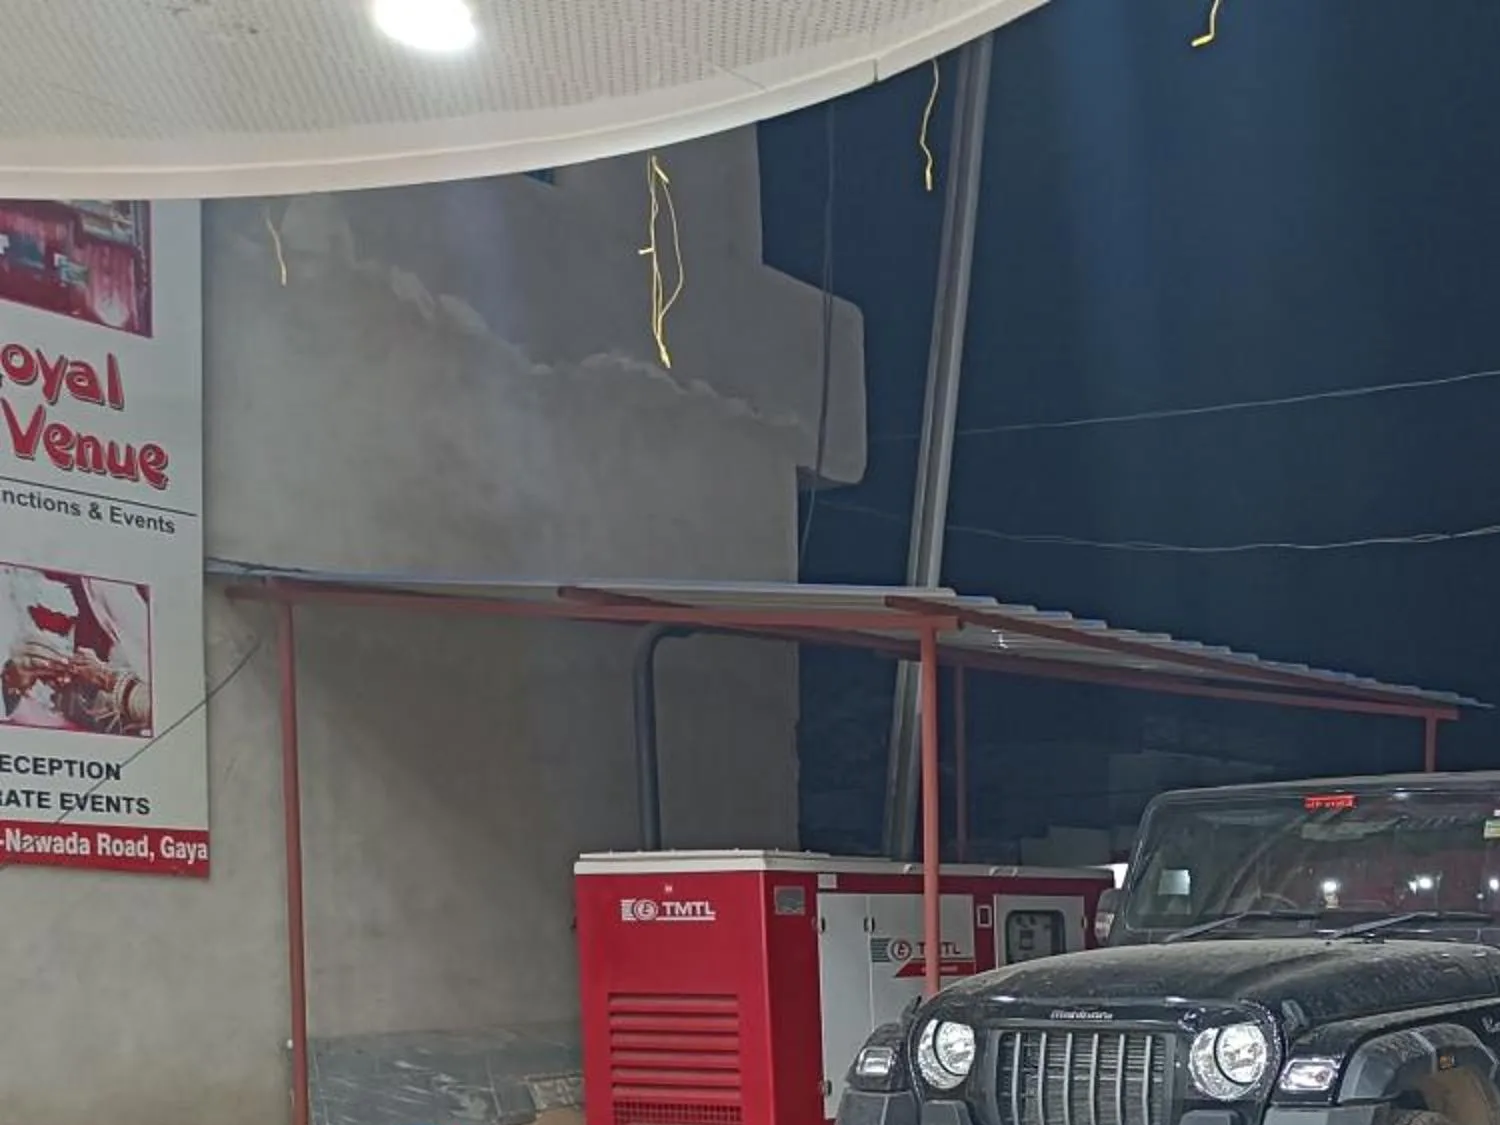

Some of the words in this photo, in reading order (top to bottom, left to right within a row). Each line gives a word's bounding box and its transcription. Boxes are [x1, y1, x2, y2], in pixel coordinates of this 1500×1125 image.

[0, 343, 125, 411] oyal
[0, 397, 169, 490] Venue
[2, 490, 81, 517] nctions
[88, 501, 103, 521] &
[110, 505, 175, 535] Events
[0, 753, 121, 781] ECEPTION
[60, 792, 151, 816] EVENTS
[96, 832, 155, 861] Road,
[160, 836, 208, 865] Gaya
[661, 901, 716, 915] TMTL
[917, 941, 961, 955] TTL
